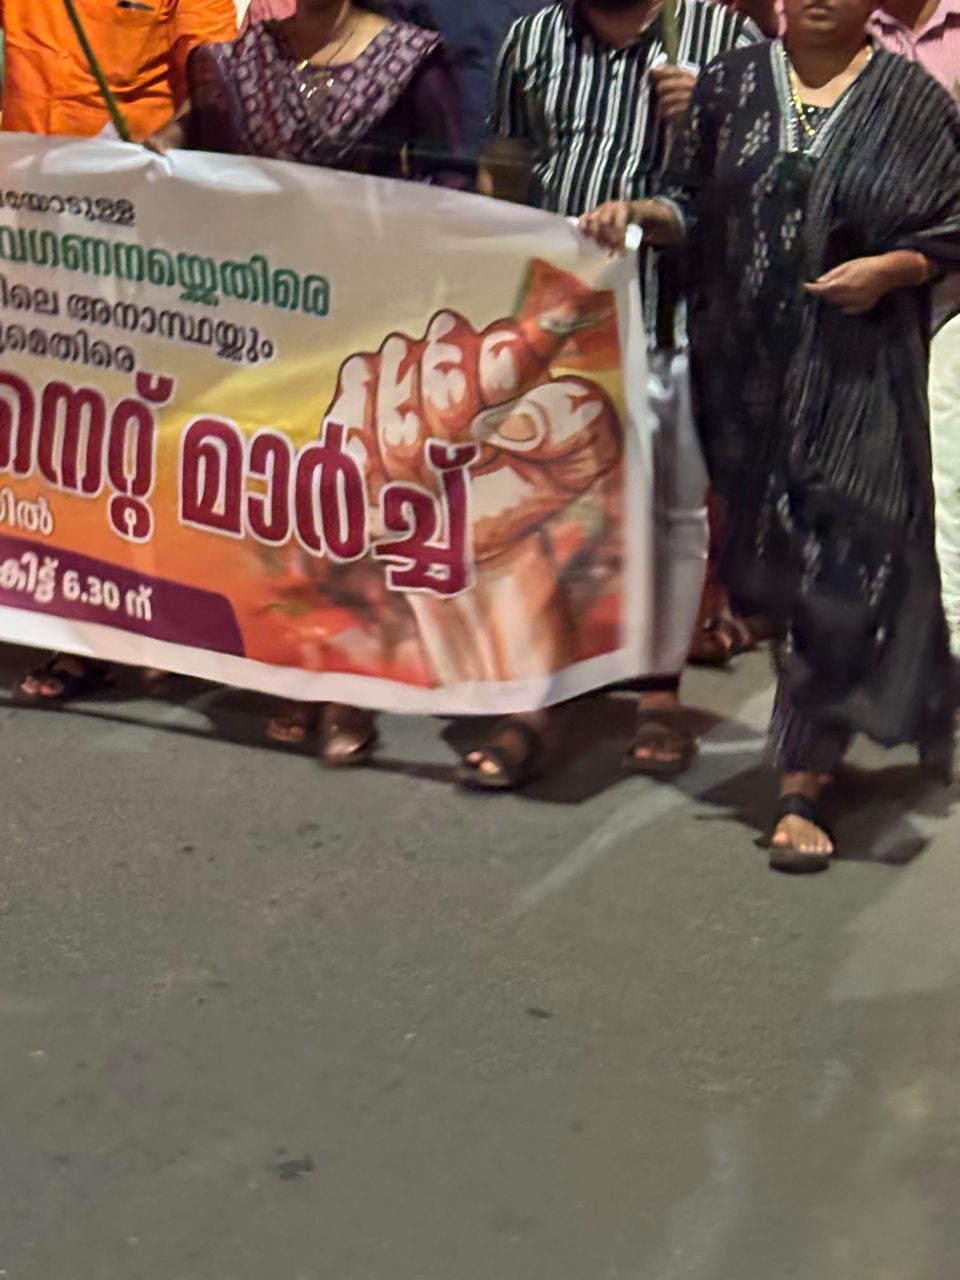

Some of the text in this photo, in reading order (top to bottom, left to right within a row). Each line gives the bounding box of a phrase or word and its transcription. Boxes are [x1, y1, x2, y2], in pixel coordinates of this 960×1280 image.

[179, 413, 480, 597] മാർച്ച്
[61, 568, 121, 614] 6.30
[124, 583, 154, 622] ന്
